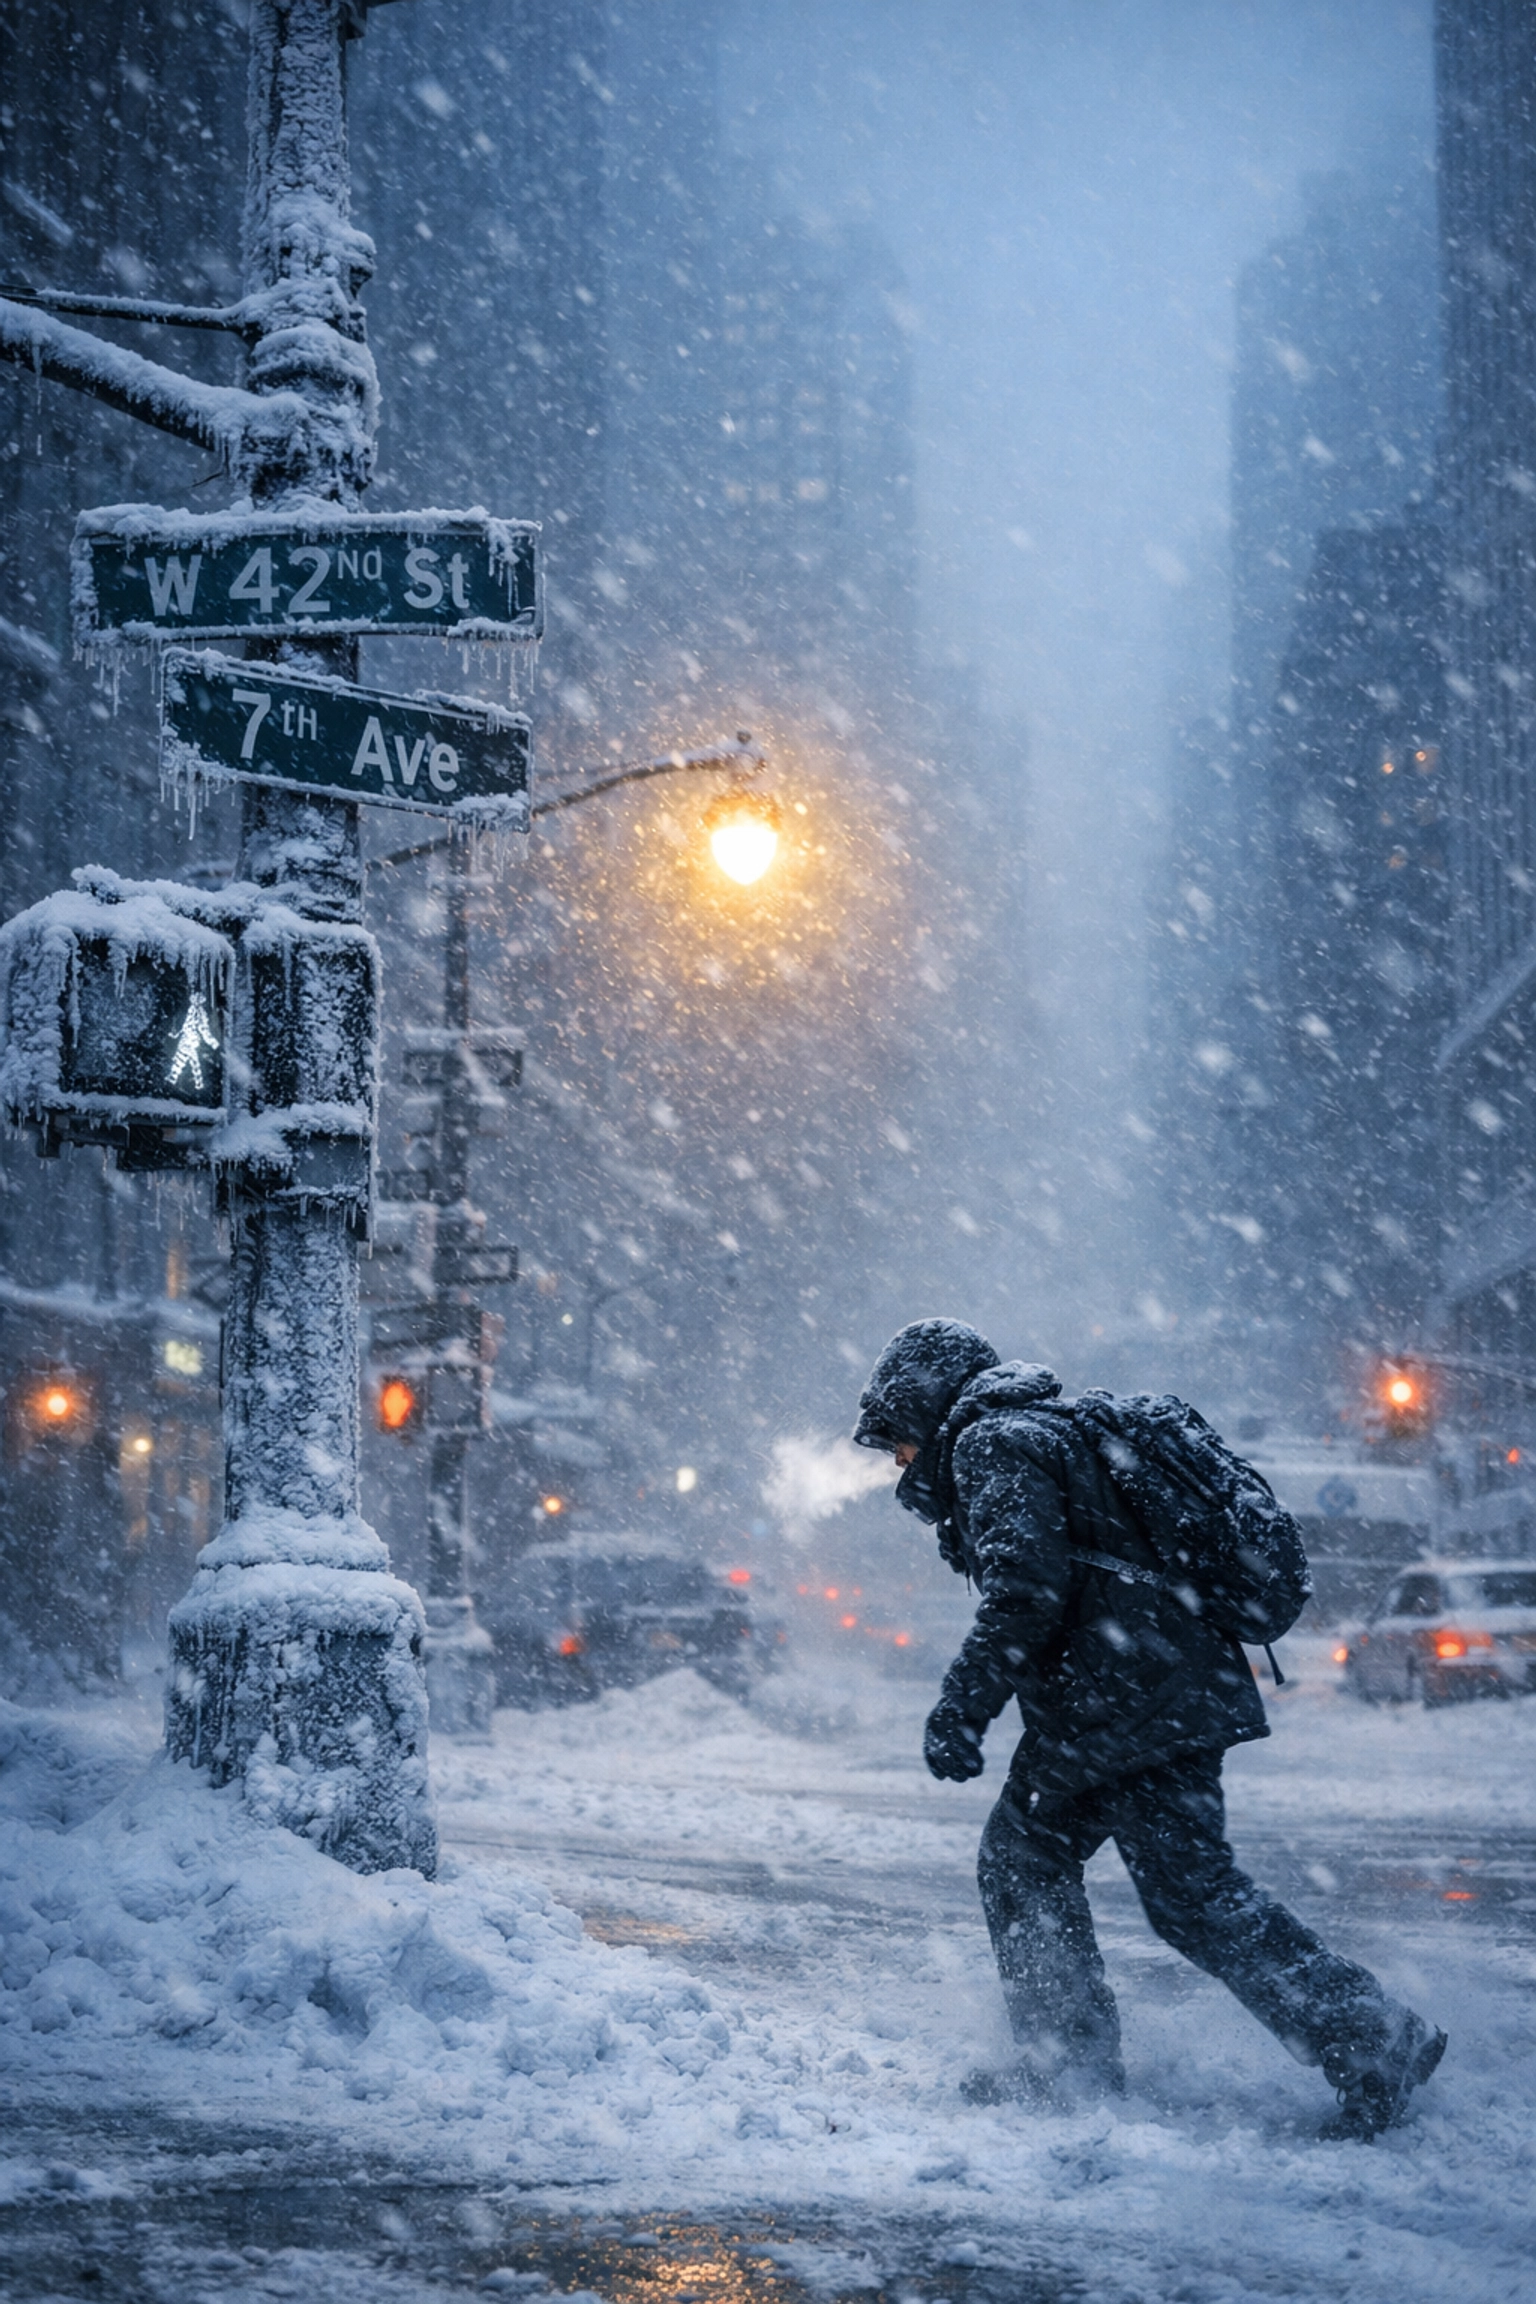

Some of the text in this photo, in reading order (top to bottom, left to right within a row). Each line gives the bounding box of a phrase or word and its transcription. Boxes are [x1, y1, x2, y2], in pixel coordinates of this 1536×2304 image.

[144, 554, 200, 616] W
[404, 549, 470, 609] St
[351, 716, 460, 792] Ave
